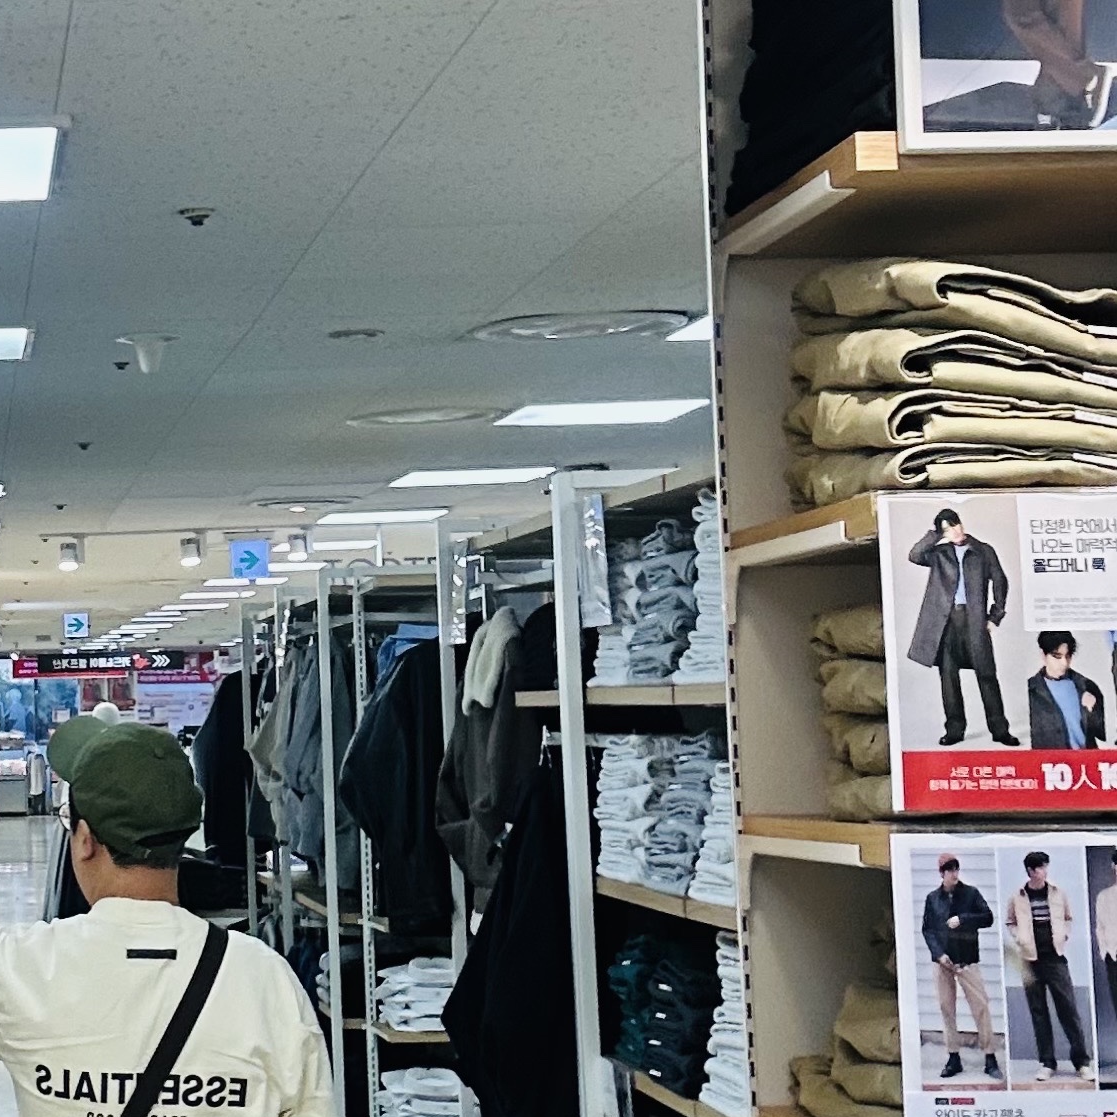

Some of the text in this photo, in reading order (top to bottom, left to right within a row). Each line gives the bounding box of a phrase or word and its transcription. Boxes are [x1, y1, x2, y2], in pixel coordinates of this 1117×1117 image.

[1030, 518, 1073, 534] 단정한
[1031, 538, 1073, 553] 나오는
[1033, 558, 1088, 573] 올드머니
